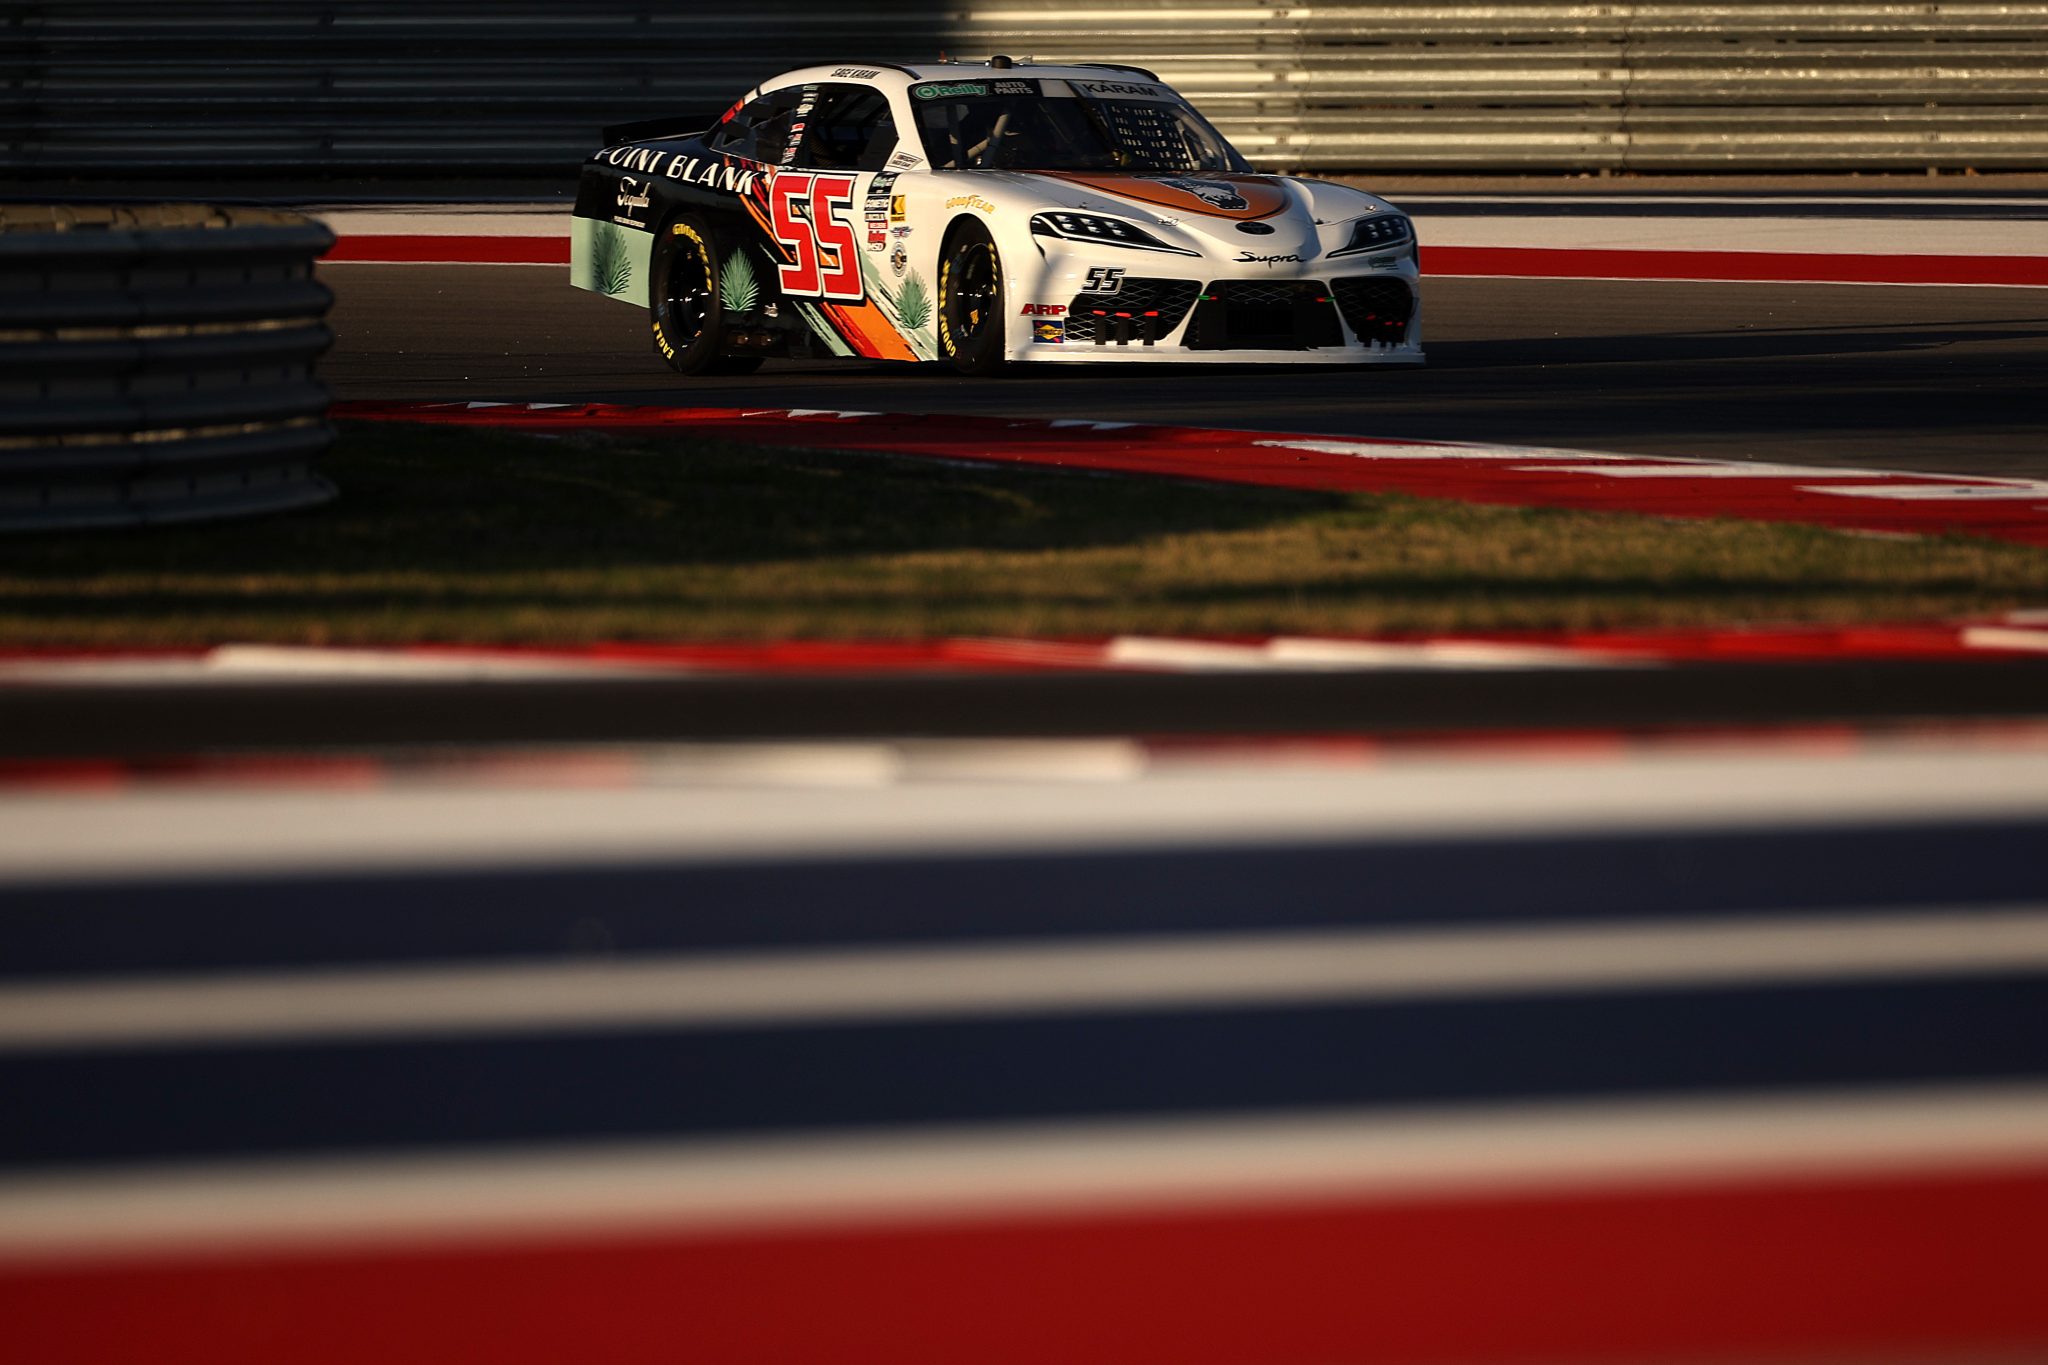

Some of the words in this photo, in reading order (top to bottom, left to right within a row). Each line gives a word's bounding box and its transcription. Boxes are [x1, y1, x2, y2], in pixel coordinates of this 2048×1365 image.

[915, 83, 987, 99] O'Reilly
[994, 87, 1034, 95] PARTS
[1082, 83, 1159, 97] KARAM
[594, 145, 668, 174] POINT
[666, 154, 760, 195] BLANK
[769, 171, 864, 300] 55
[1232, 251, 1307, 269] Supra
[1081, 266, 1126, 295] 55
[1020, 303, 1067, 316] ARP
